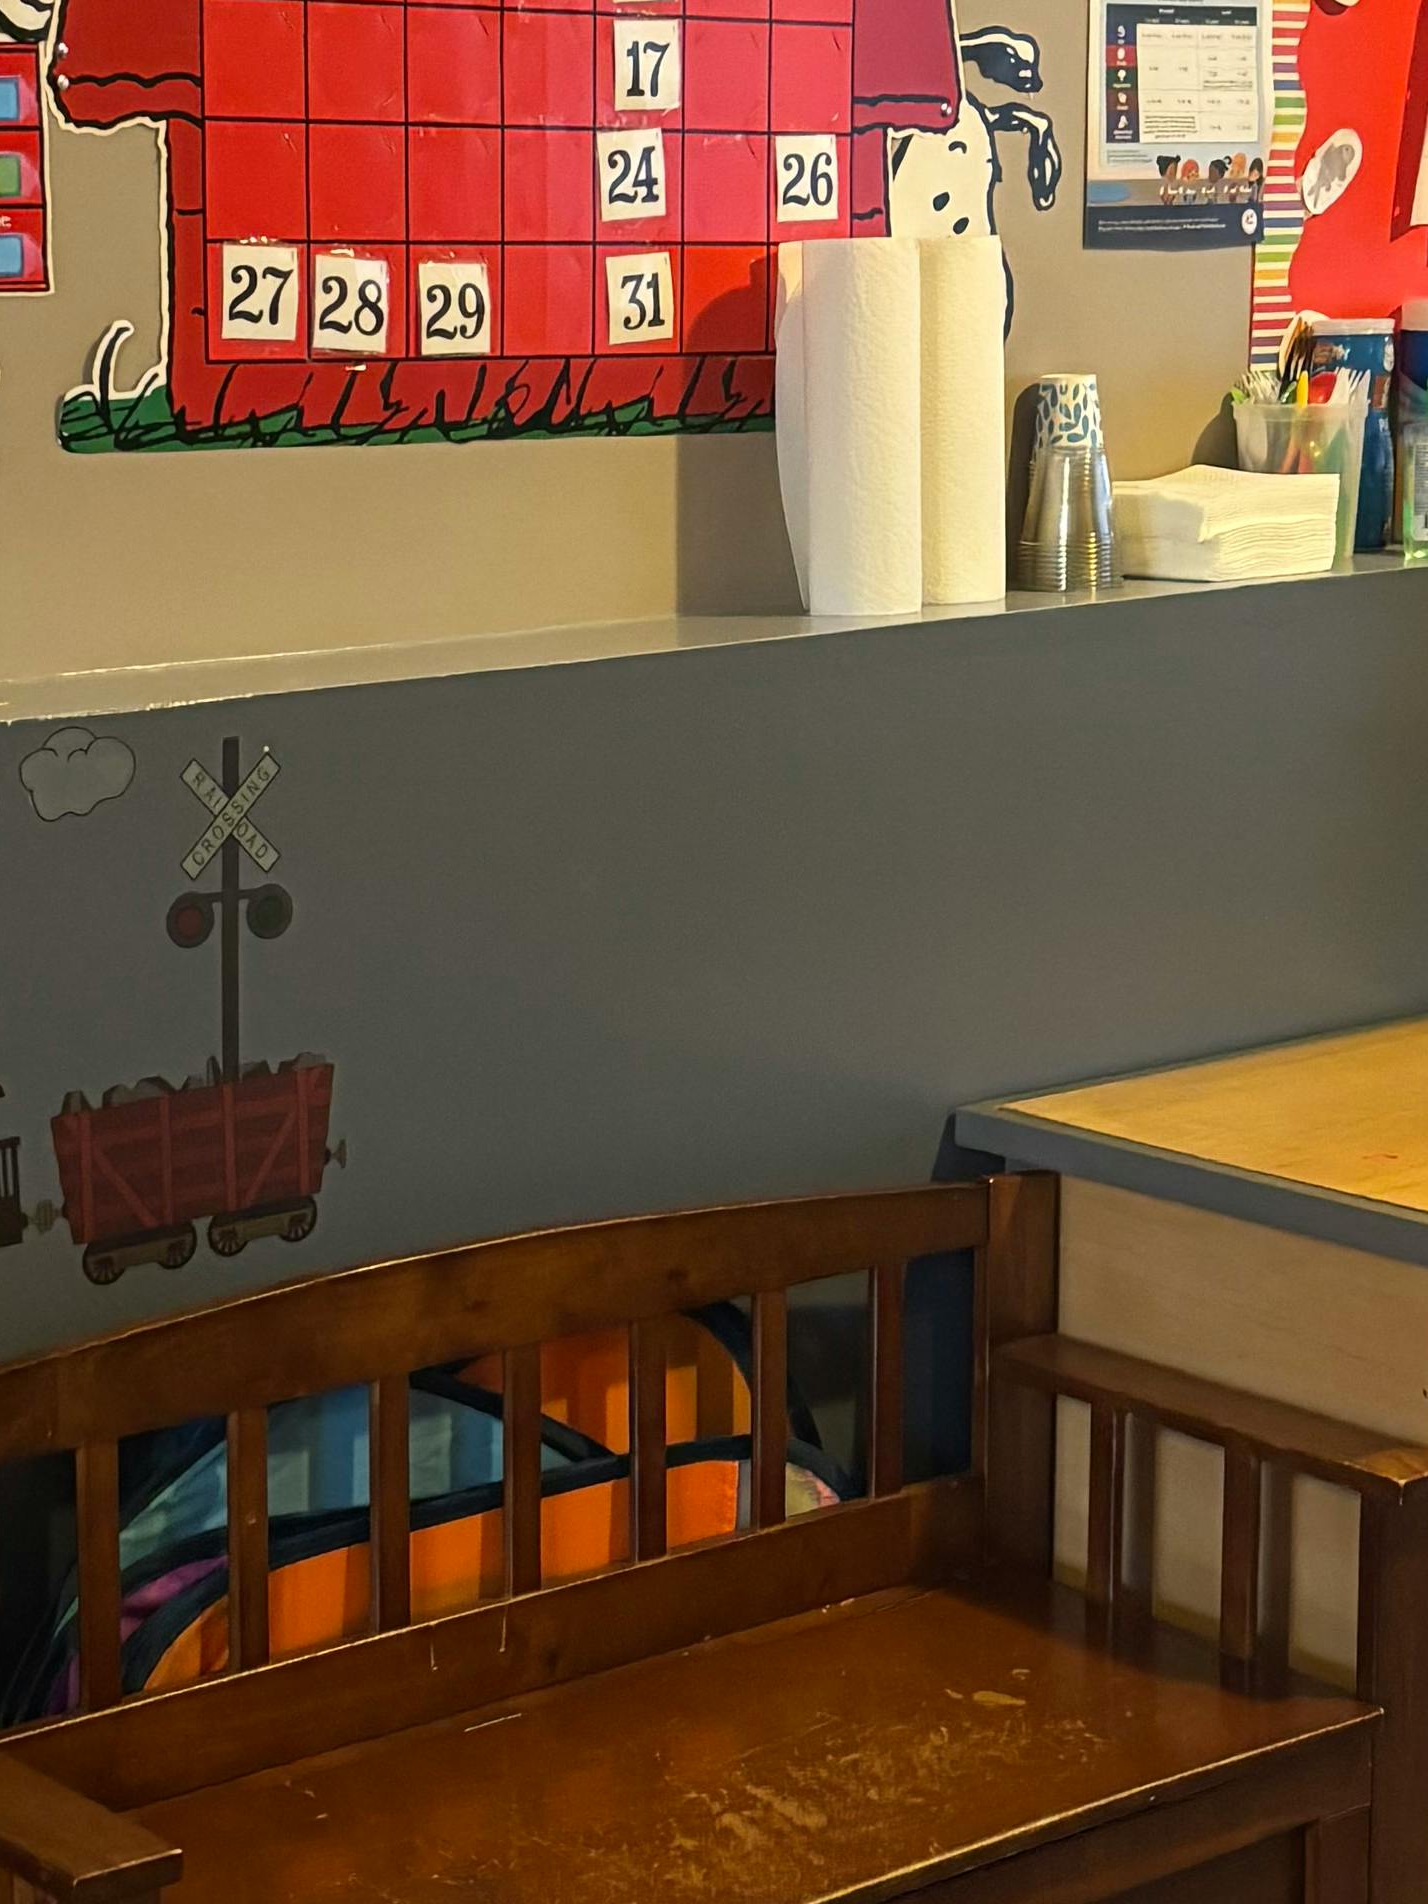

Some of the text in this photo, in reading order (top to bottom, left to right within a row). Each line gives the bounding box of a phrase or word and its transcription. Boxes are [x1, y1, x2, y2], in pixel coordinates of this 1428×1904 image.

[624, 41, 668, 100] 17
[607, 145, 835, 210] 24 26
[226, 263, 666, 342] 27 28 29 31
[191, 765, 271, 867] CROSSING
